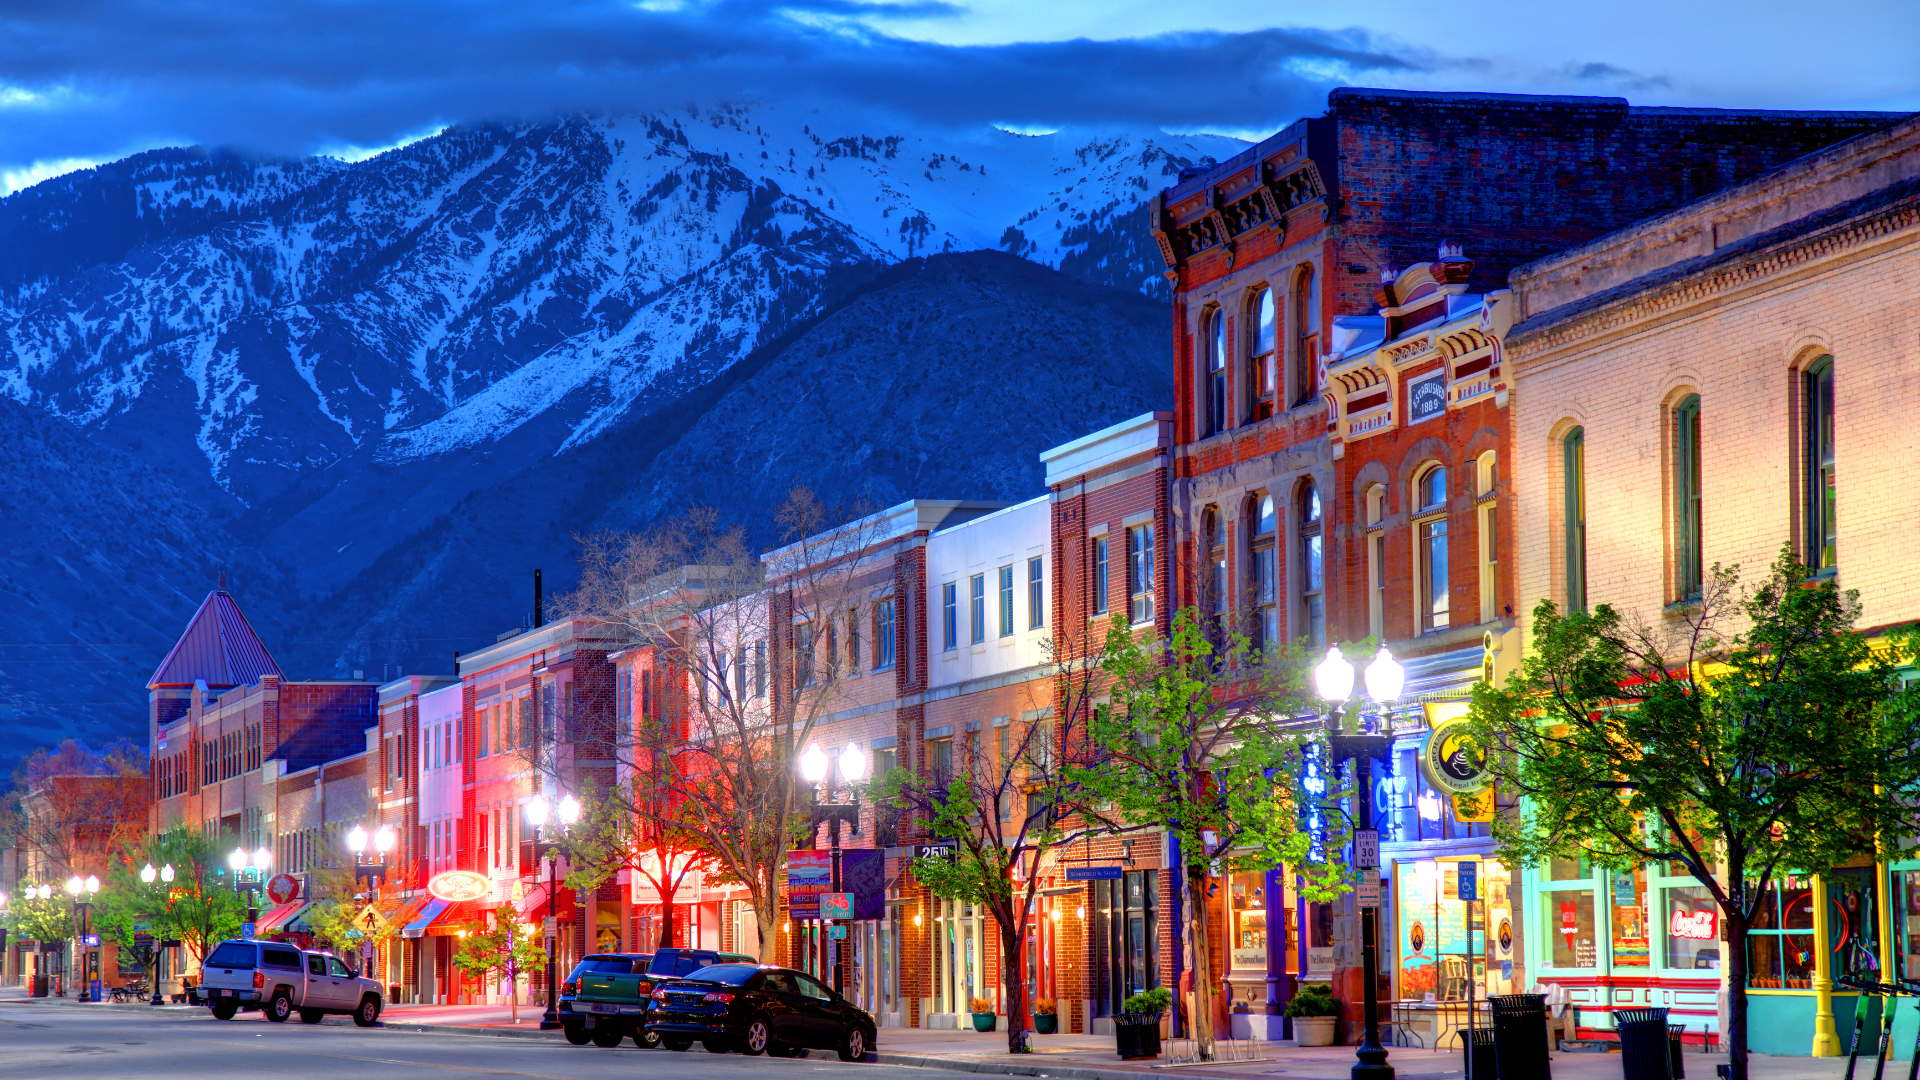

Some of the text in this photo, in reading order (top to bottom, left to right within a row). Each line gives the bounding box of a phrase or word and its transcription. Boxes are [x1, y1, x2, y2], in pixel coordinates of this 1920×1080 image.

[1413, 382, 1445, 408] ESTABLISHED
[1421, 399, 1439, 414] 1889
[1431, 726, 1451, 769] GROUND
[1450, 780, 1470, 789] Legal
[1361, 847, 1374, 857] 30
[1240, 954, 1256, 964] Diamond
[1255, 954, 1266, 964] Room
